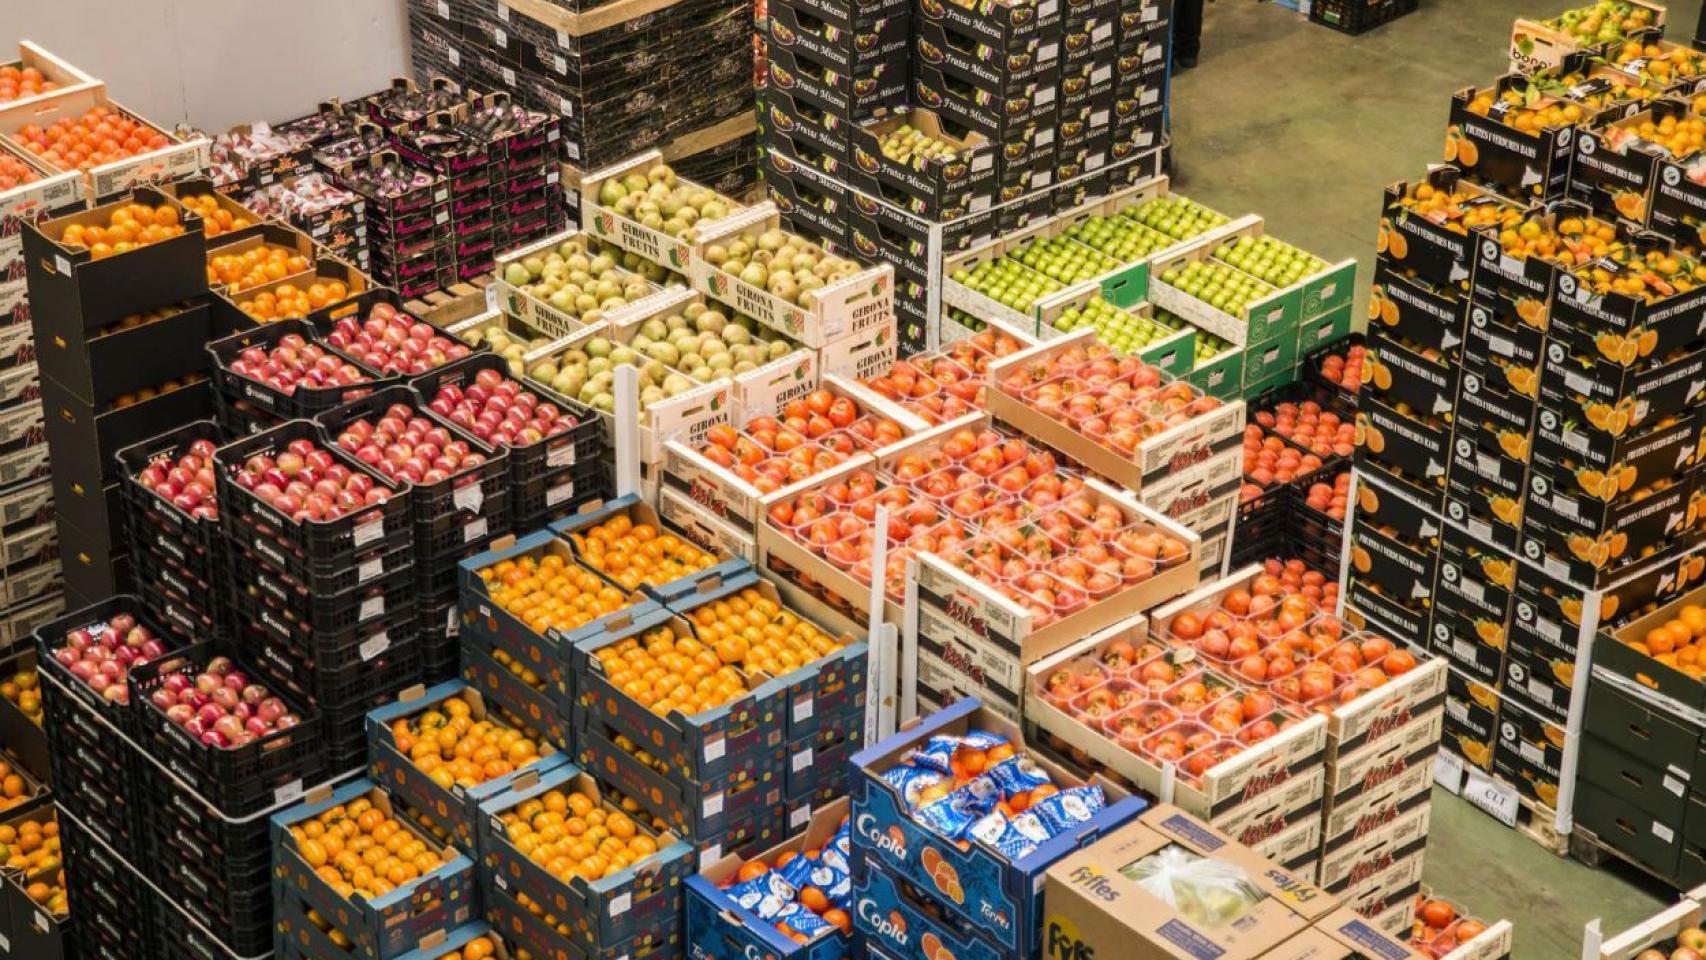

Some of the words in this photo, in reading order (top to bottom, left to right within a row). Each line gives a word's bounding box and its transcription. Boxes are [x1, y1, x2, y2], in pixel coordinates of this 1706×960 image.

[622, 222, 658, 245] GIRONA
[623, 234, 659, 258] FRUITS
[736, 283, 773, 309] GIRONA
[534, 305, 570, 330] GIRONA
[737, 297, 774, 323] FRUITS
[852, 298, 889, 320] GIRONA
[536, 317, 568, 337] FRUIT
[852, 310, 890, 332] FRUITS
[856, 347, 892, 370] GIRONA
[776, 381, 813, 404] GIRONA
[856, 814, 907, 860] Copla
[858, 898, 908, 945] Copla
